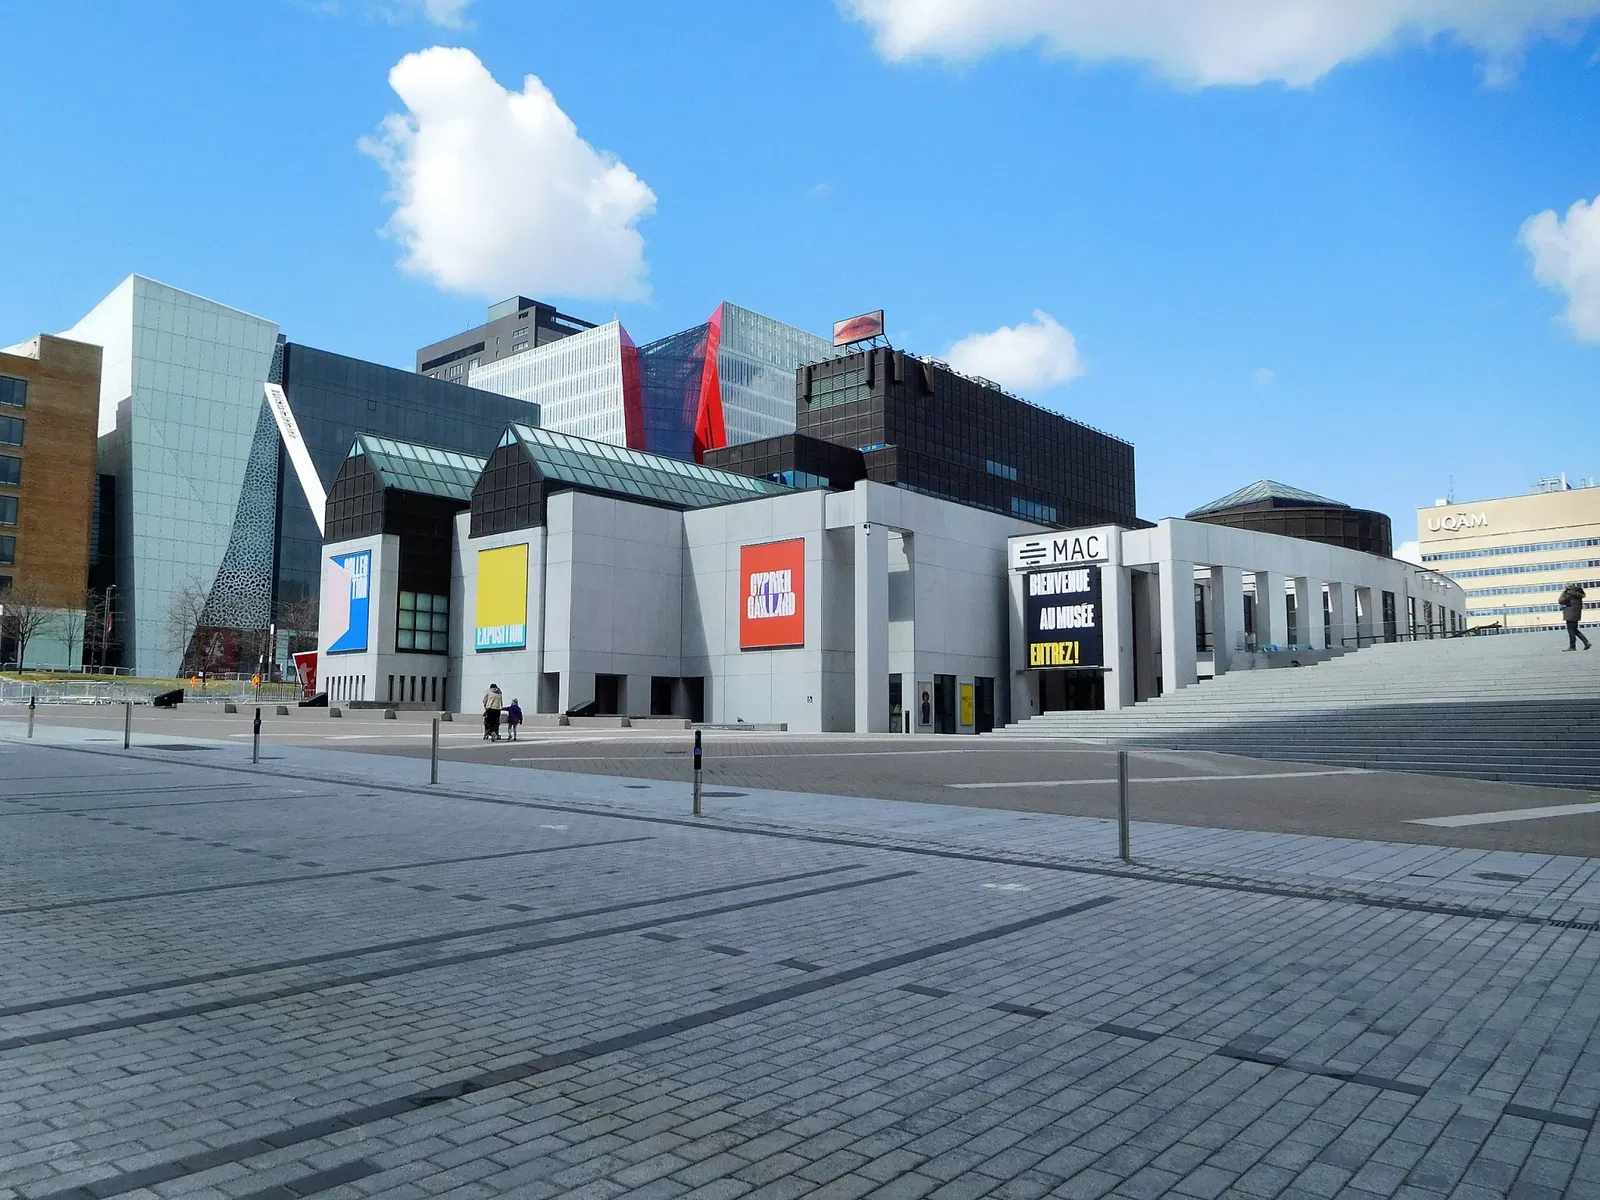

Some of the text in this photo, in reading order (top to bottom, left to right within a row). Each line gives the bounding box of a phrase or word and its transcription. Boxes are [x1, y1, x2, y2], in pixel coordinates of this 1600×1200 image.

[1053, 536, 1099, 562] MAC
[750, 569, 792, 596] CYPRIEN
[1029, 569, 1090, 596] BIENVENUE
[747, 592, 795, 620] GAILLARD
[1039, 602, 1095, 630] AU MUSÉE
[477, 624, 523, 646] EXPOSITION
